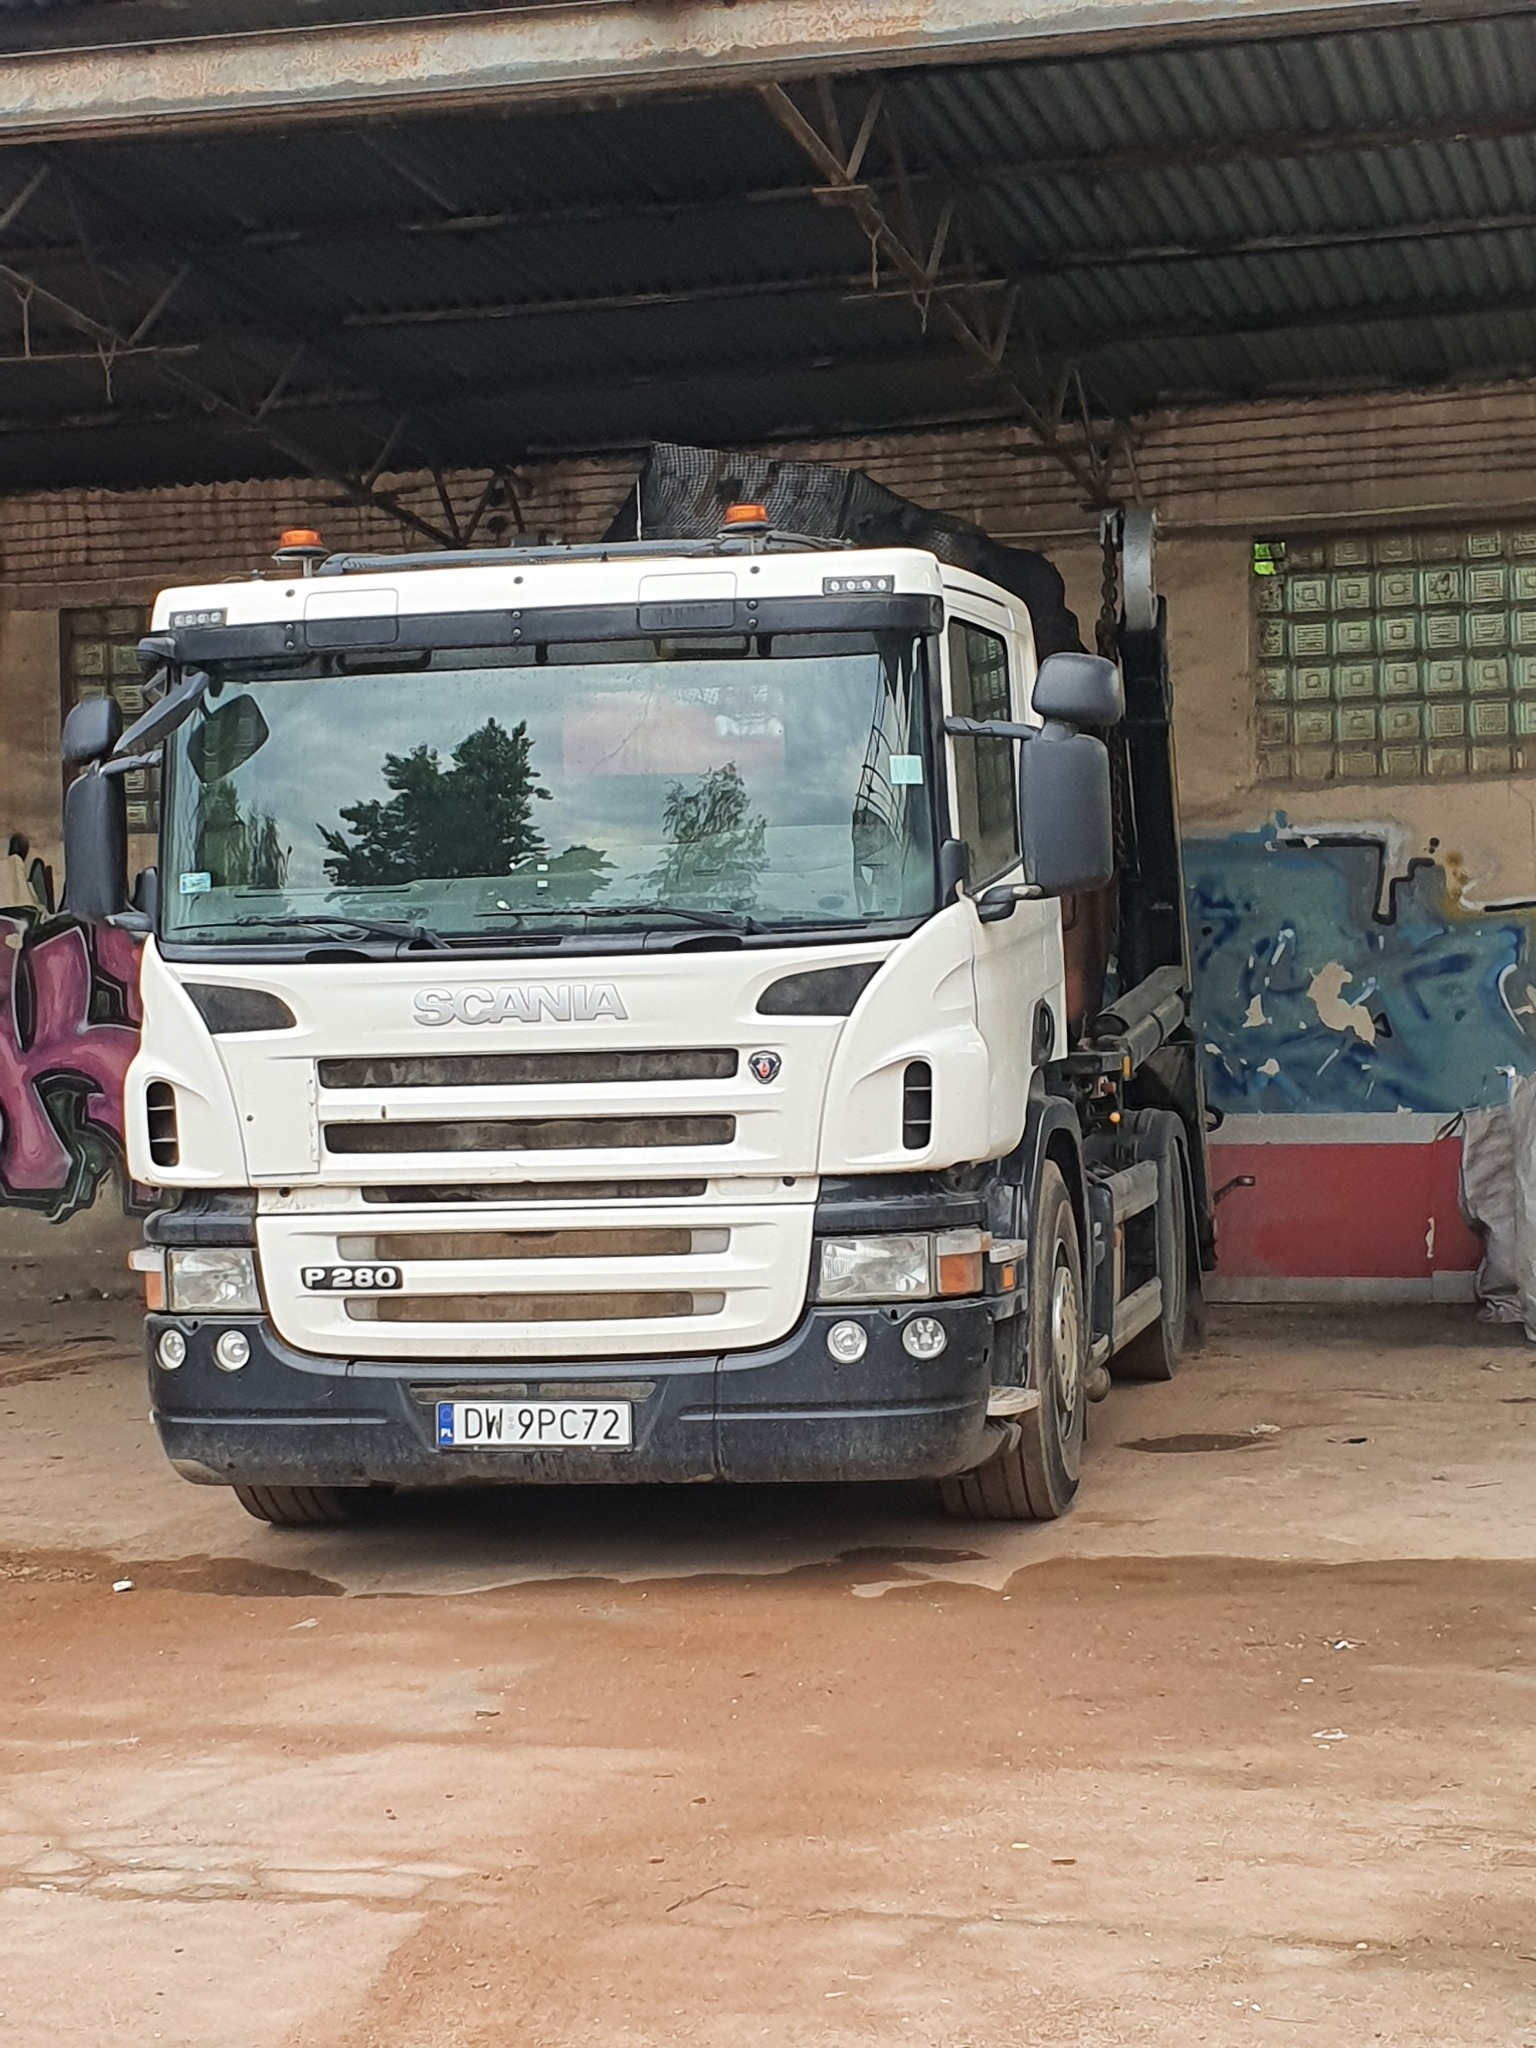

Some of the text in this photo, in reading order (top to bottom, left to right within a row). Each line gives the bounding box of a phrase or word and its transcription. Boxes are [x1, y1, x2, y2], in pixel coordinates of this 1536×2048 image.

[413, 984, 629, 1026] SCANIA
[305, 1267, 397, 1288] P 280
[464, 1408, 620, 1440] DW 9PC72
